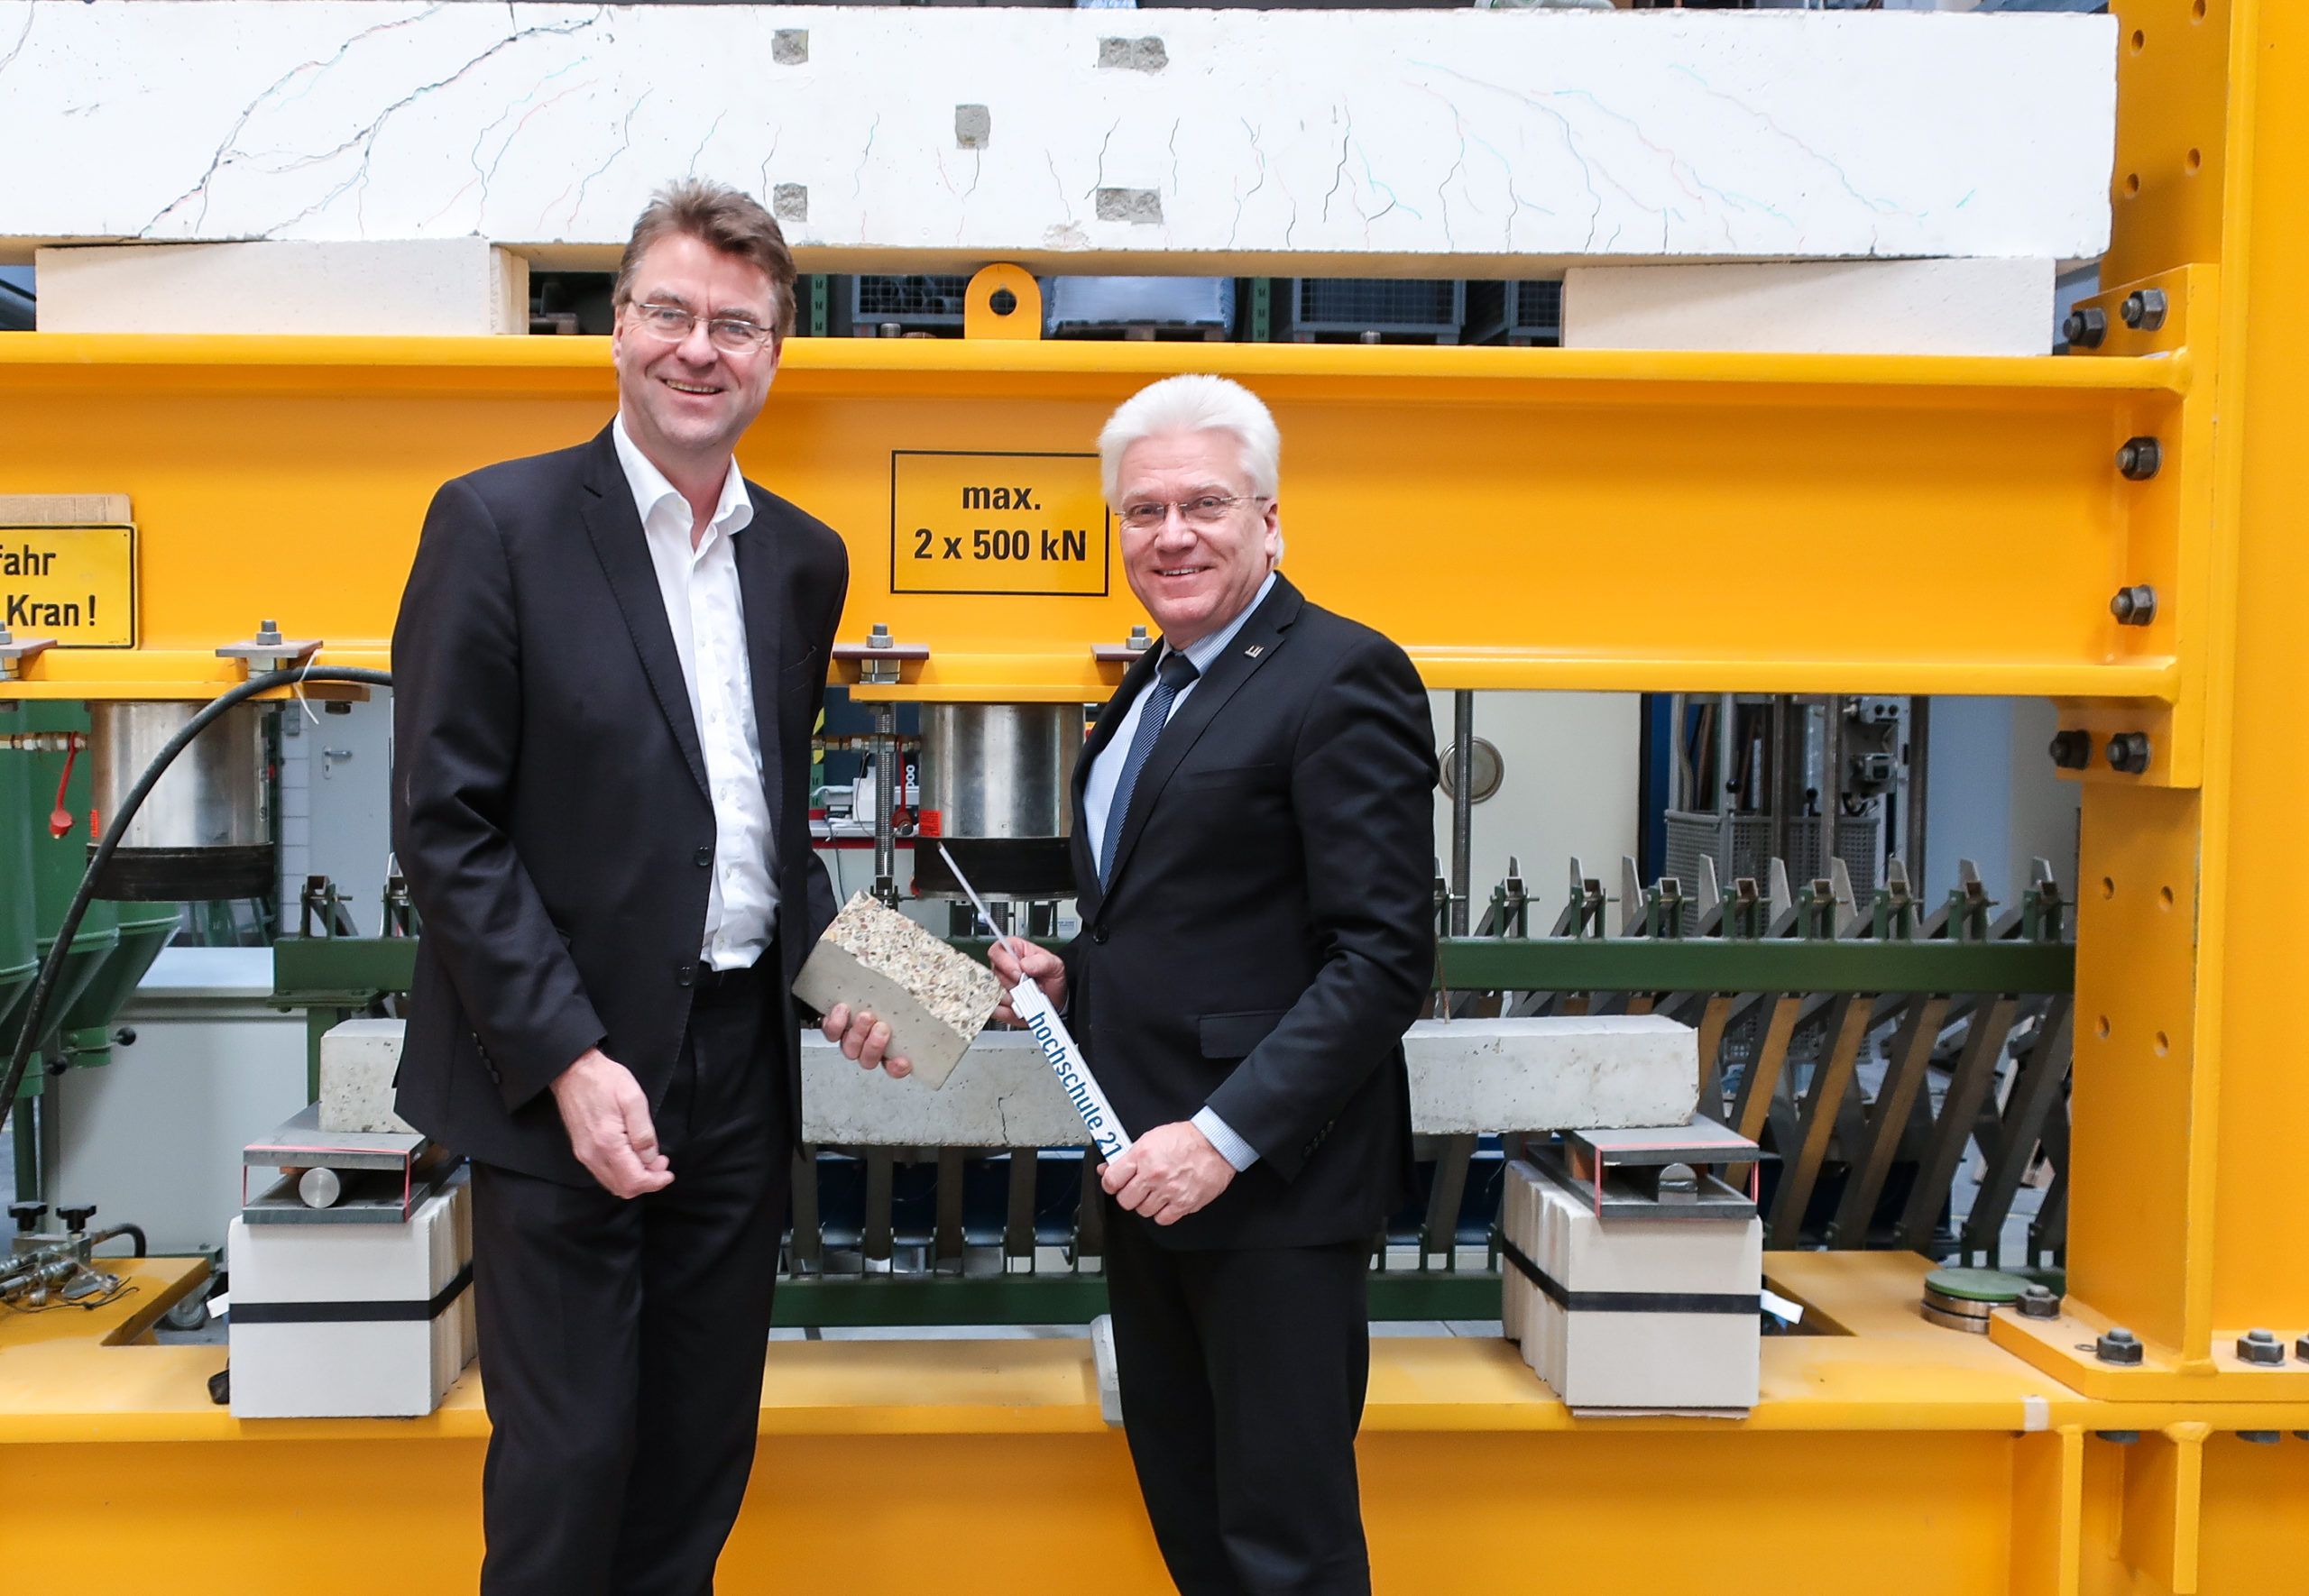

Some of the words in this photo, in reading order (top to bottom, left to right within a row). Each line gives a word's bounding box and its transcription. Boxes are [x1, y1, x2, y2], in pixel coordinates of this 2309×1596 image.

[962, 486, 1041, 510] max.
[0, 544, 56, 575] ahr
[914, 528, 933, 559] 2
[943, 537, 962, 559] x
[973, 529, 1030, 561] 500
[1041, 529, 1086, 561] kN
[1027, 1011, 1103, 1131] hochschule
[1095, 1132, 1122, 1160] 21
